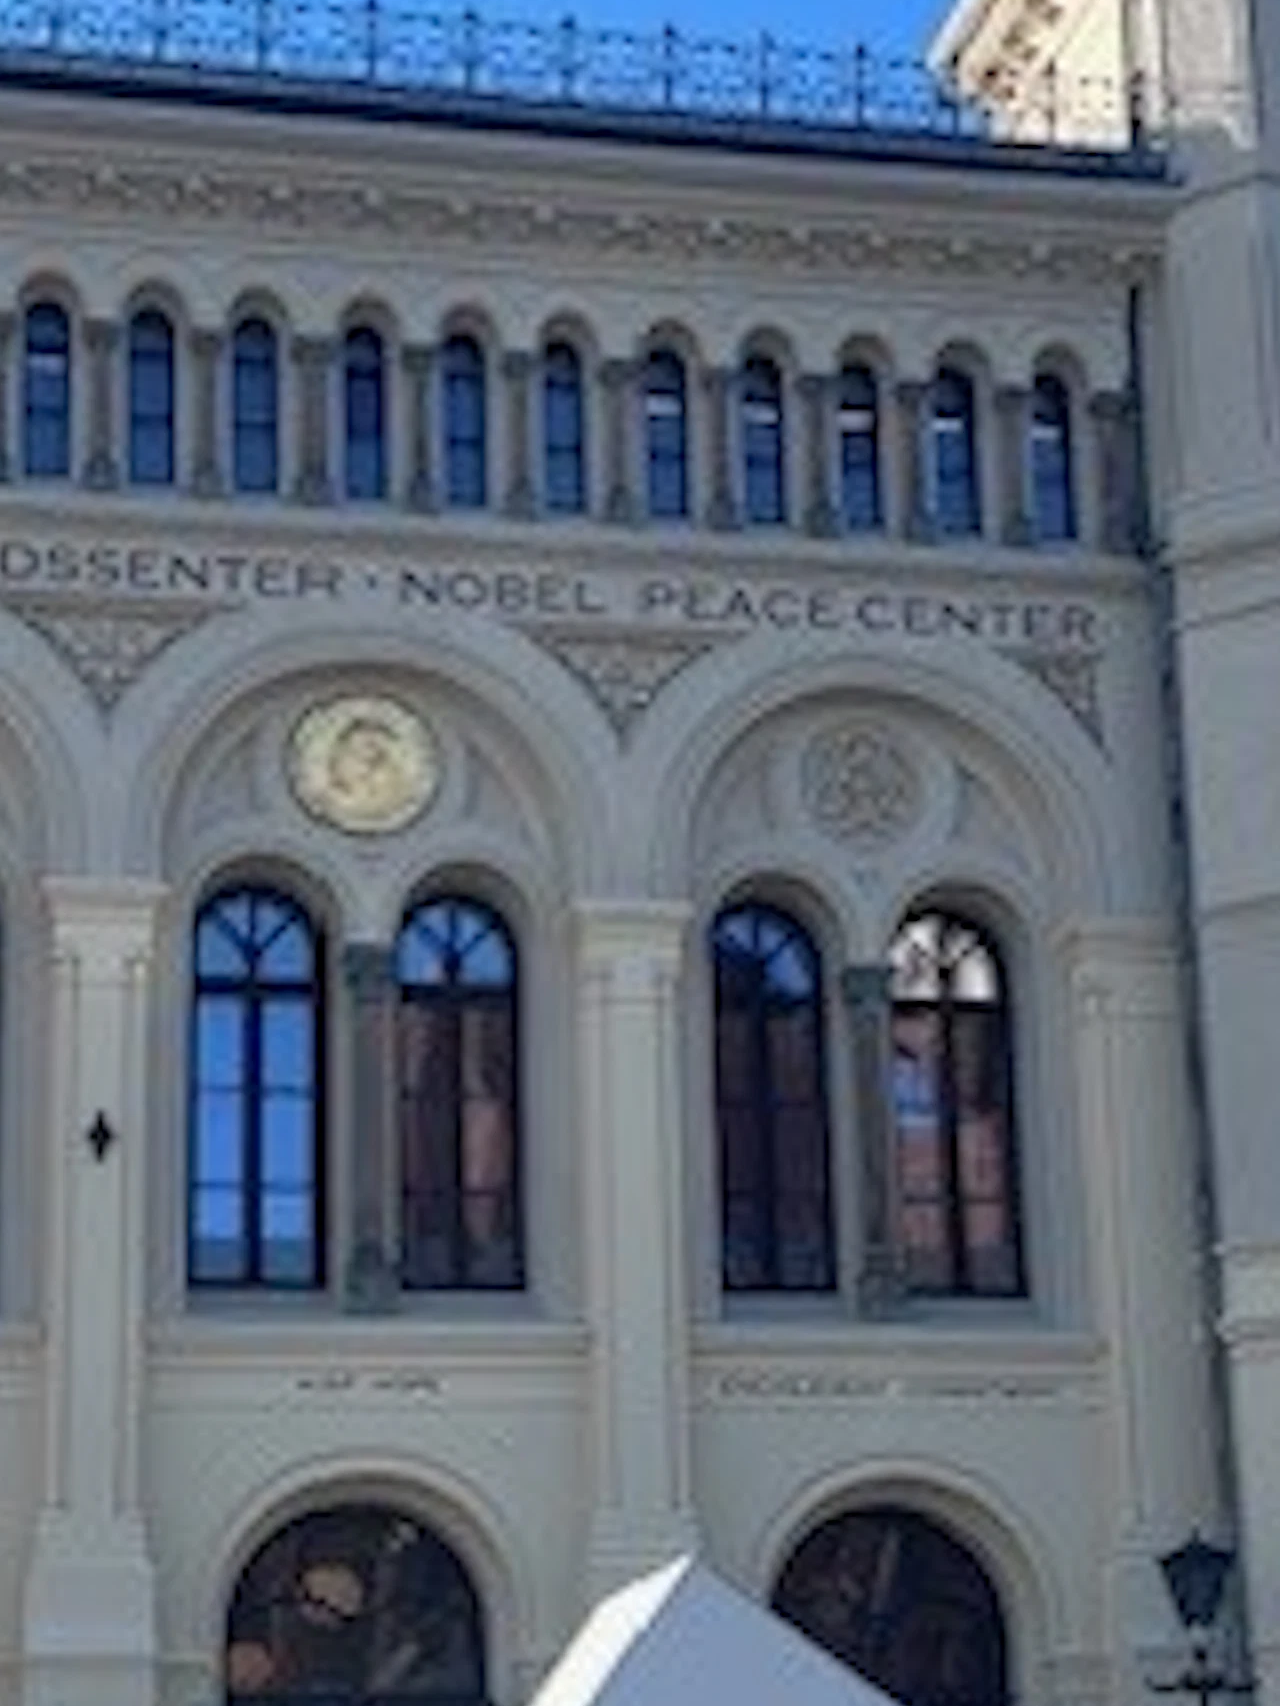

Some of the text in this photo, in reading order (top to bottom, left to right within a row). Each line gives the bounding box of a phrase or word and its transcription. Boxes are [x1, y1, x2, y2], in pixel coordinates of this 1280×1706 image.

[396, 568, 603, 615] NOBEL
[639, 579, 843, 631] PEACE
[852, 591, 1101, 645] CENTER
